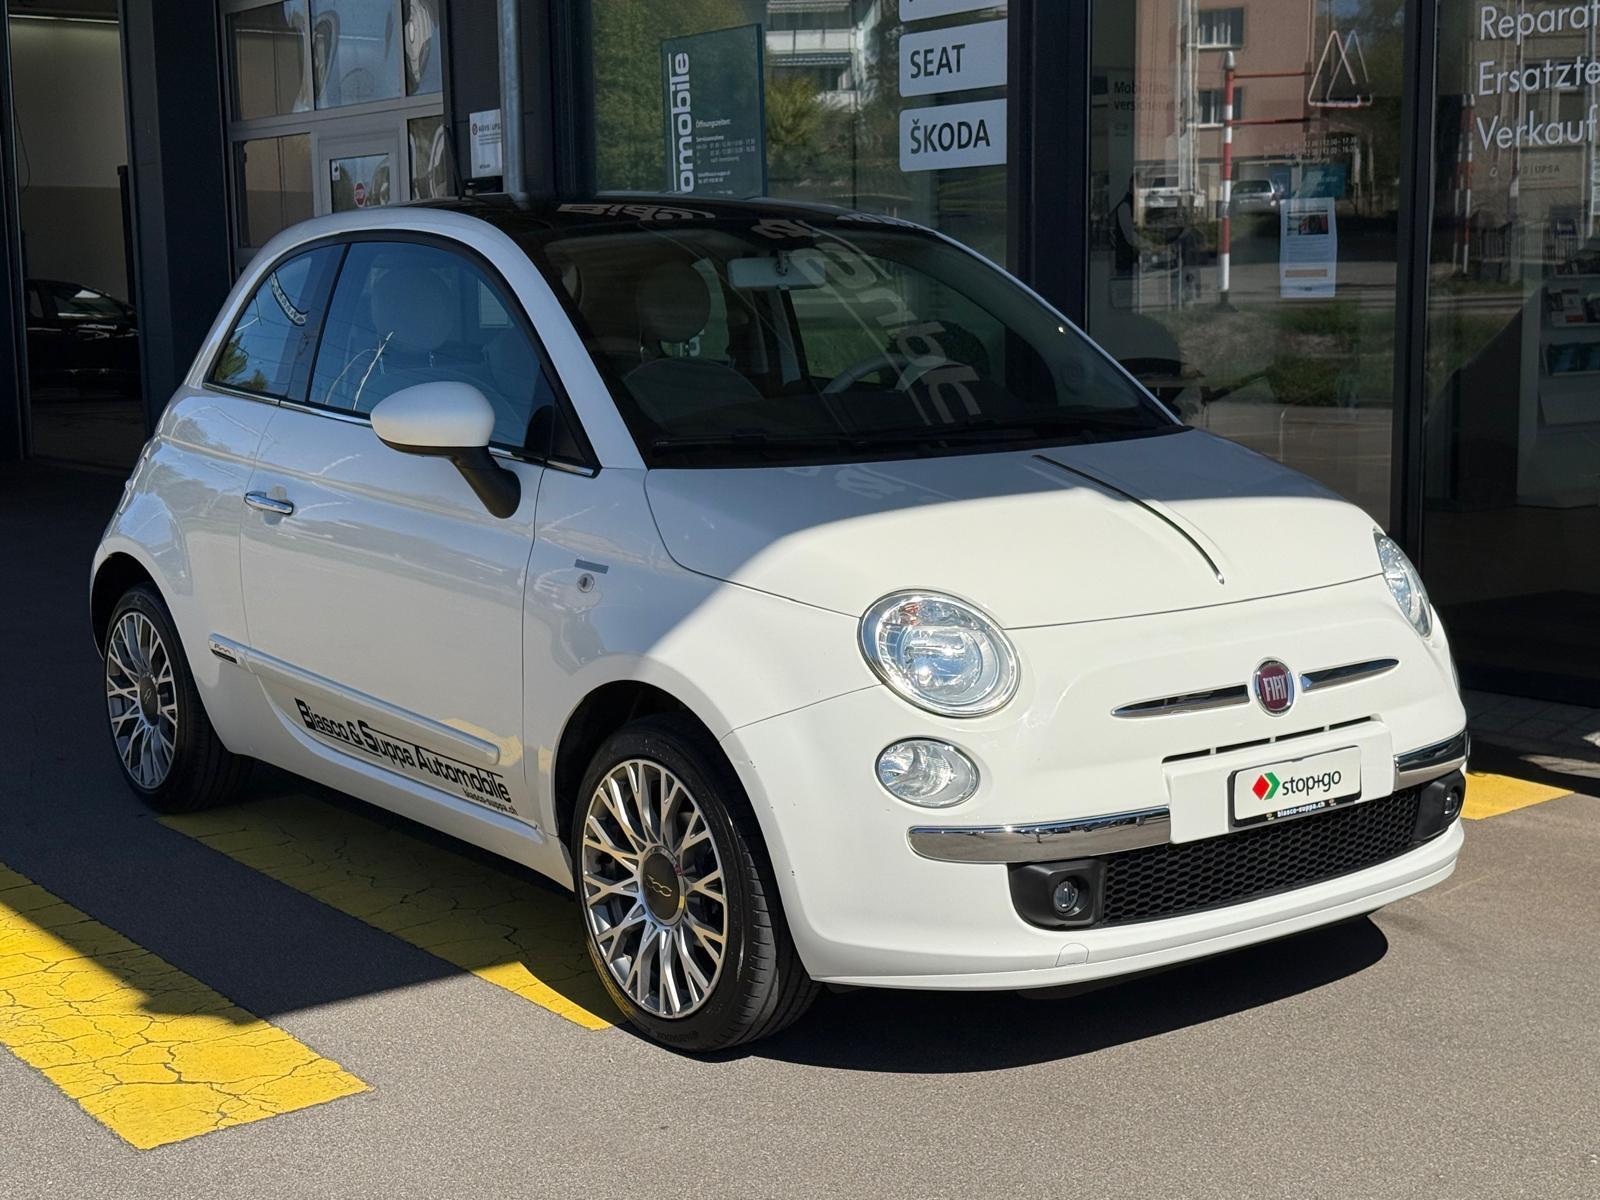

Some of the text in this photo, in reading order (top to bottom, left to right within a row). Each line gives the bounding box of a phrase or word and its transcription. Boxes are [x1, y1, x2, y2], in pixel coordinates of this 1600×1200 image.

[910, 43, 966, 79] SEAT
[1479, 56, 1600, 96] Ersatzte
[910, 118, 990, 155] ŠKODA
[1476, 104, 1598, 151] Verkauf
[1263, 674, 1287, 702] FIAT
[295, 698, 512, 804] Biasco & Suppa Automobile
[1282, 770, 1342, 796] stop+go
[1277, 800, 1326, 818] biasco-suppa.ch
